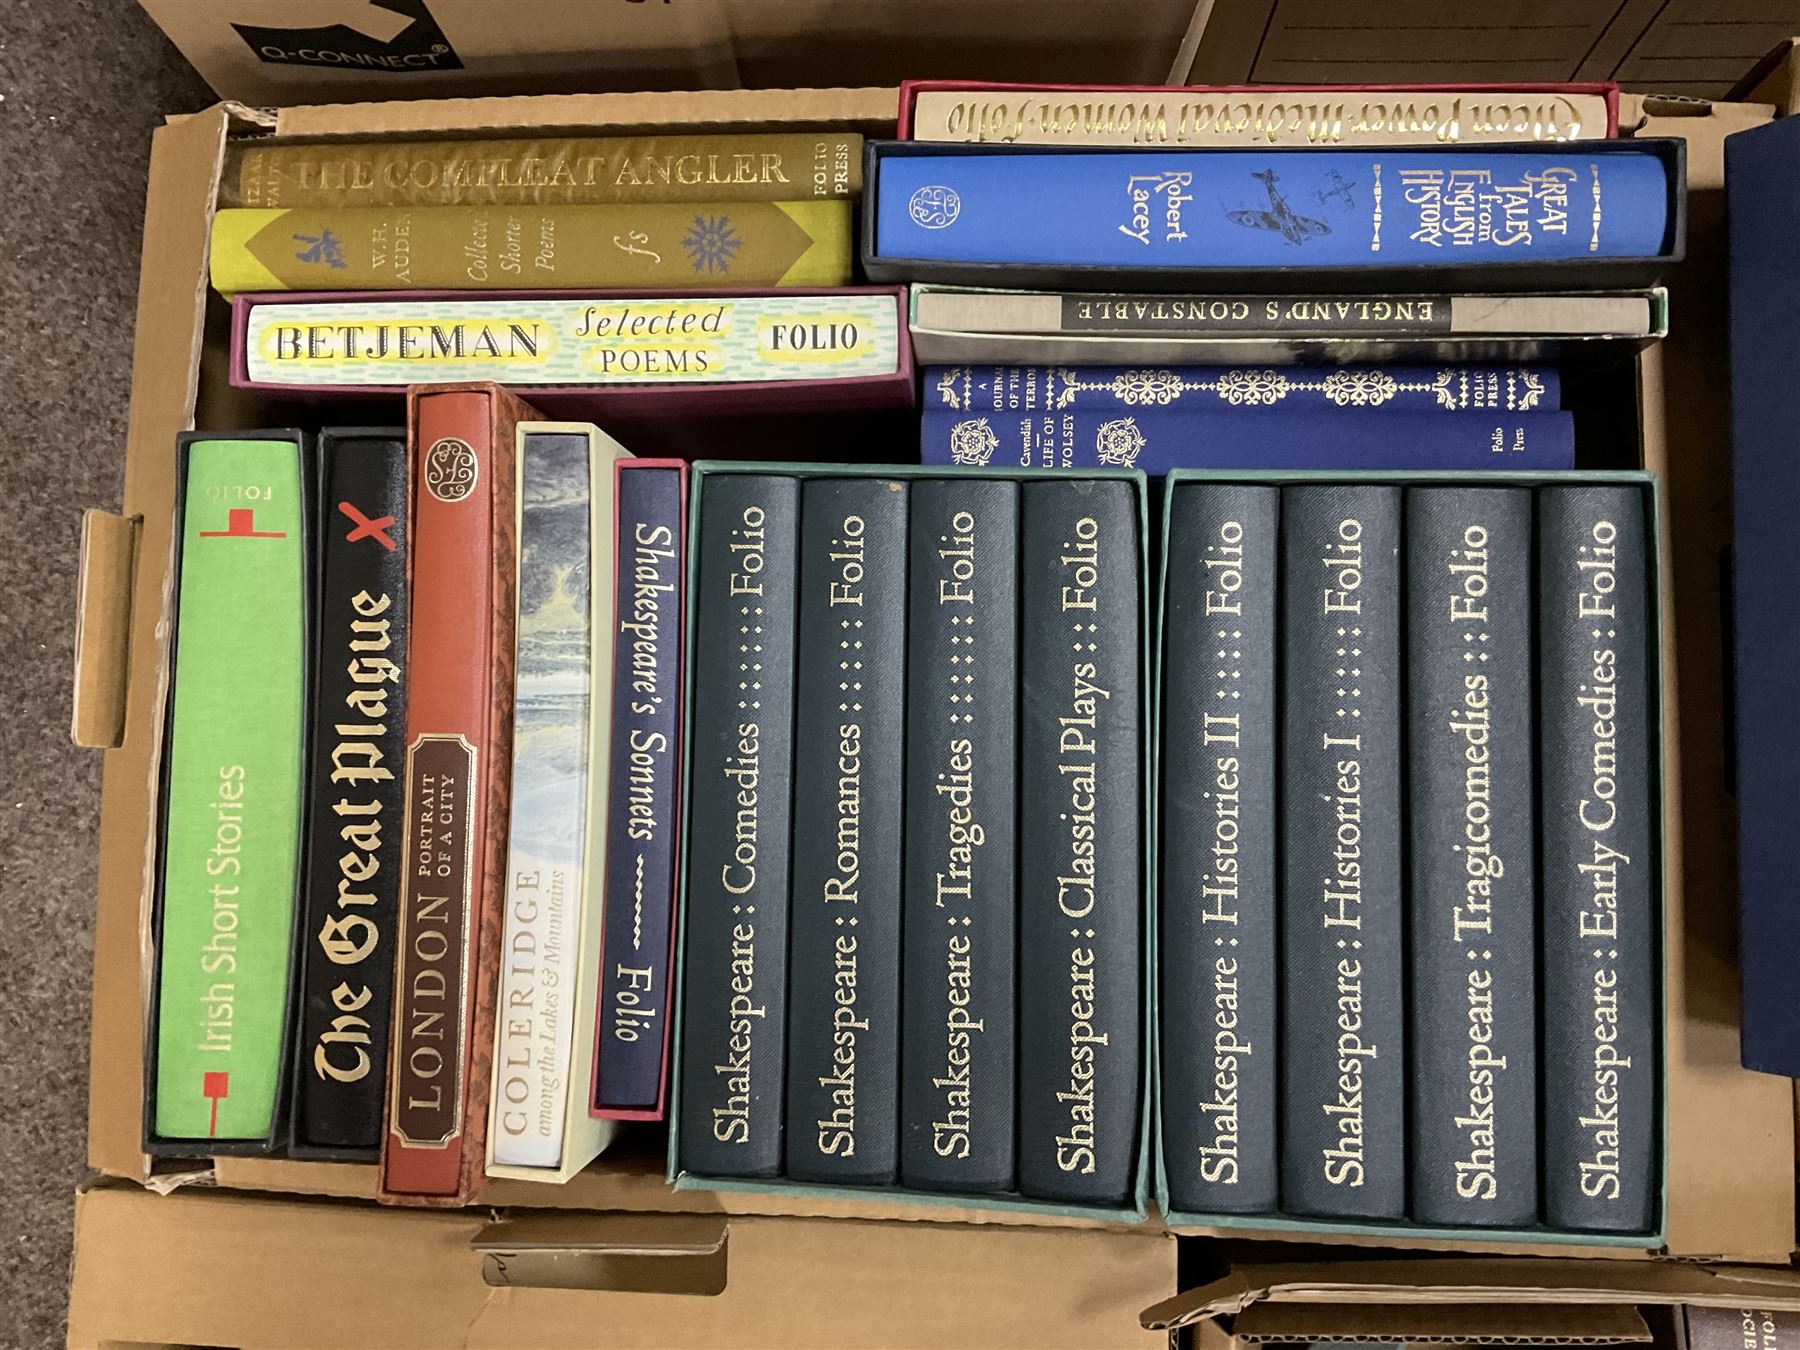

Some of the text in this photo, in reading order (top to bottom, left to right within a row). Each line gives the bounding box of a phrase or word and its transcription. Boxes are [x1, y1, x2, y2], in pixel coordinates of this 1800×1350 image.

[1468, 97, 1582, 141] Eileen
[290, 153, 790, 189] THE COMPLEAT ANGLER
[813, 142, 829, 196] FOLIO
[835, 143, 850, 194] PRESS
[1154, 171, 1193, 243] Robert
[1524, 167, 1578, 235] GREAT
[535, 217, 555, 273] Poems
[1118, 175, 1150, 245] Lacey
[1398, 169, 1445, 247] HISTORY
[1442, 170, 1492, 246] ENGLISH
[1478, 192, 1504, 243] from
[1492, 179, 1534, 246] TALES
[276, 324, 540, 360] BETJEMAN
[575, 306, 727, 337] Selected
[771, 323, 858, 350] FOLIO
[1079, 301, 1433, 321] ENGLAND'S CONSTABLE
[601, 349, 708, 373] POEMS
[978, 382, 988, 390] A
[1009, 392, 1019, 409] OF
[1020, 418, 1032, 467] Cavendish
[1043, 415, 1055, 468] LIFE OF
[1062, 414, 1074, 468] WOLSEY
[1492, 427, 1503, 453] Folio
[1513, 428, 1524, 451] Press
[207, 485, 272, 500] FOLIO
[730, 506, 765, 597] Folio
[829, 515, 865, 607] Folio
[939, 511, 975, 605] Folio
[1061, 517, 1098, 612] Folio
[1204, 521, 1243, 616] Folio
[1322, 518, 1362, 614] Folio
[1449, 524, 1488, 622] Folio
[1577, 520, 1616, 618] Folio
[1059, 663, 1110, 754] Plays
[1203, 712, 1240, 748] II
[1323, 733, 1361, 750] I
[1577, 649, 1616, 831] Comedies
[615, 523, 675, 1042] Shakespeare's Sonnets Folio
[722, 722, 760, 895] Comedies
[824, 724, 861, 903] Romances
[1449, 675, 1504, 942] Tragicomedies
[314, 589, 401, 1083] The Great Plague
[418, 774, 435, 876] PORTRAIT
[437, 774, 455, 877] OF A CITY
[936, 738, 985, 907] Tragedies
[1057, 763, 1096, 918] Classical
[1202, 757, 1240, 925] Histories
[1323, 760, 1361, 929] Histories
[198, 764, 245, 1052] Irish Short Stories
[1577, 840, 1630, 940] Early
[408, 893, 450, 1111] LONDON
[503, 870, 541, 1137] COLERIDGE
[537, 870, 565, 1137] among the Lakes & Mountains
[1760, 1311, 1777, 1350] FOLI
